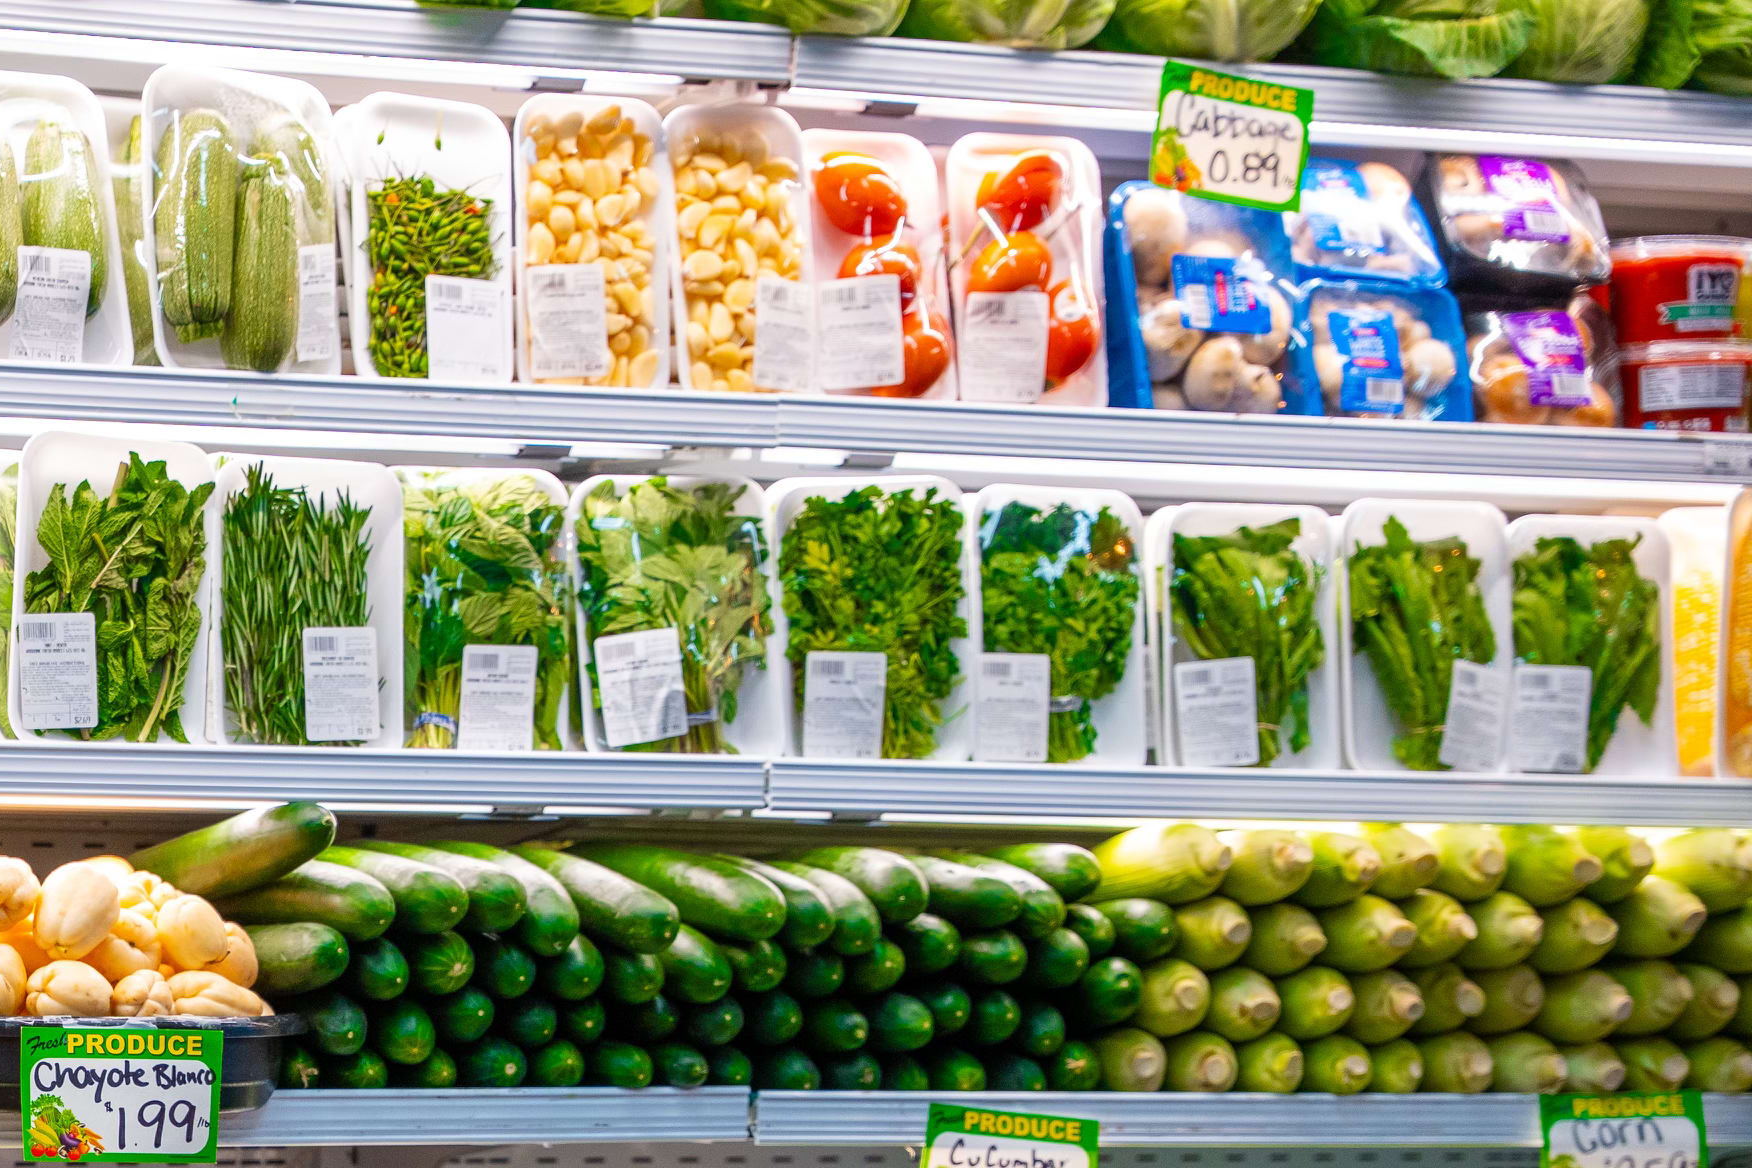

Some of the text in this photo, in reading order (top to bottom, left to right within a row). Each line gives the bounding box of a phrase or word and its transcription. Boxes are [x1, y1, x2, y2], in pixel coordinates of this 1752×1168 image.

[1189, 70, 1298, 111] PRODUCE
[1209, 149, 1282, 188] 0.89
[25, 1031, 203, 1056] Fresh PRODUCE
[33, 1060, 150, 1104] Chayote
[1572, 1094, 1686, 1118] PRODUCE
[964, 1111, 1082, 1142] PRODUCE
[1571, 1117, 1665, 1155] Corn
